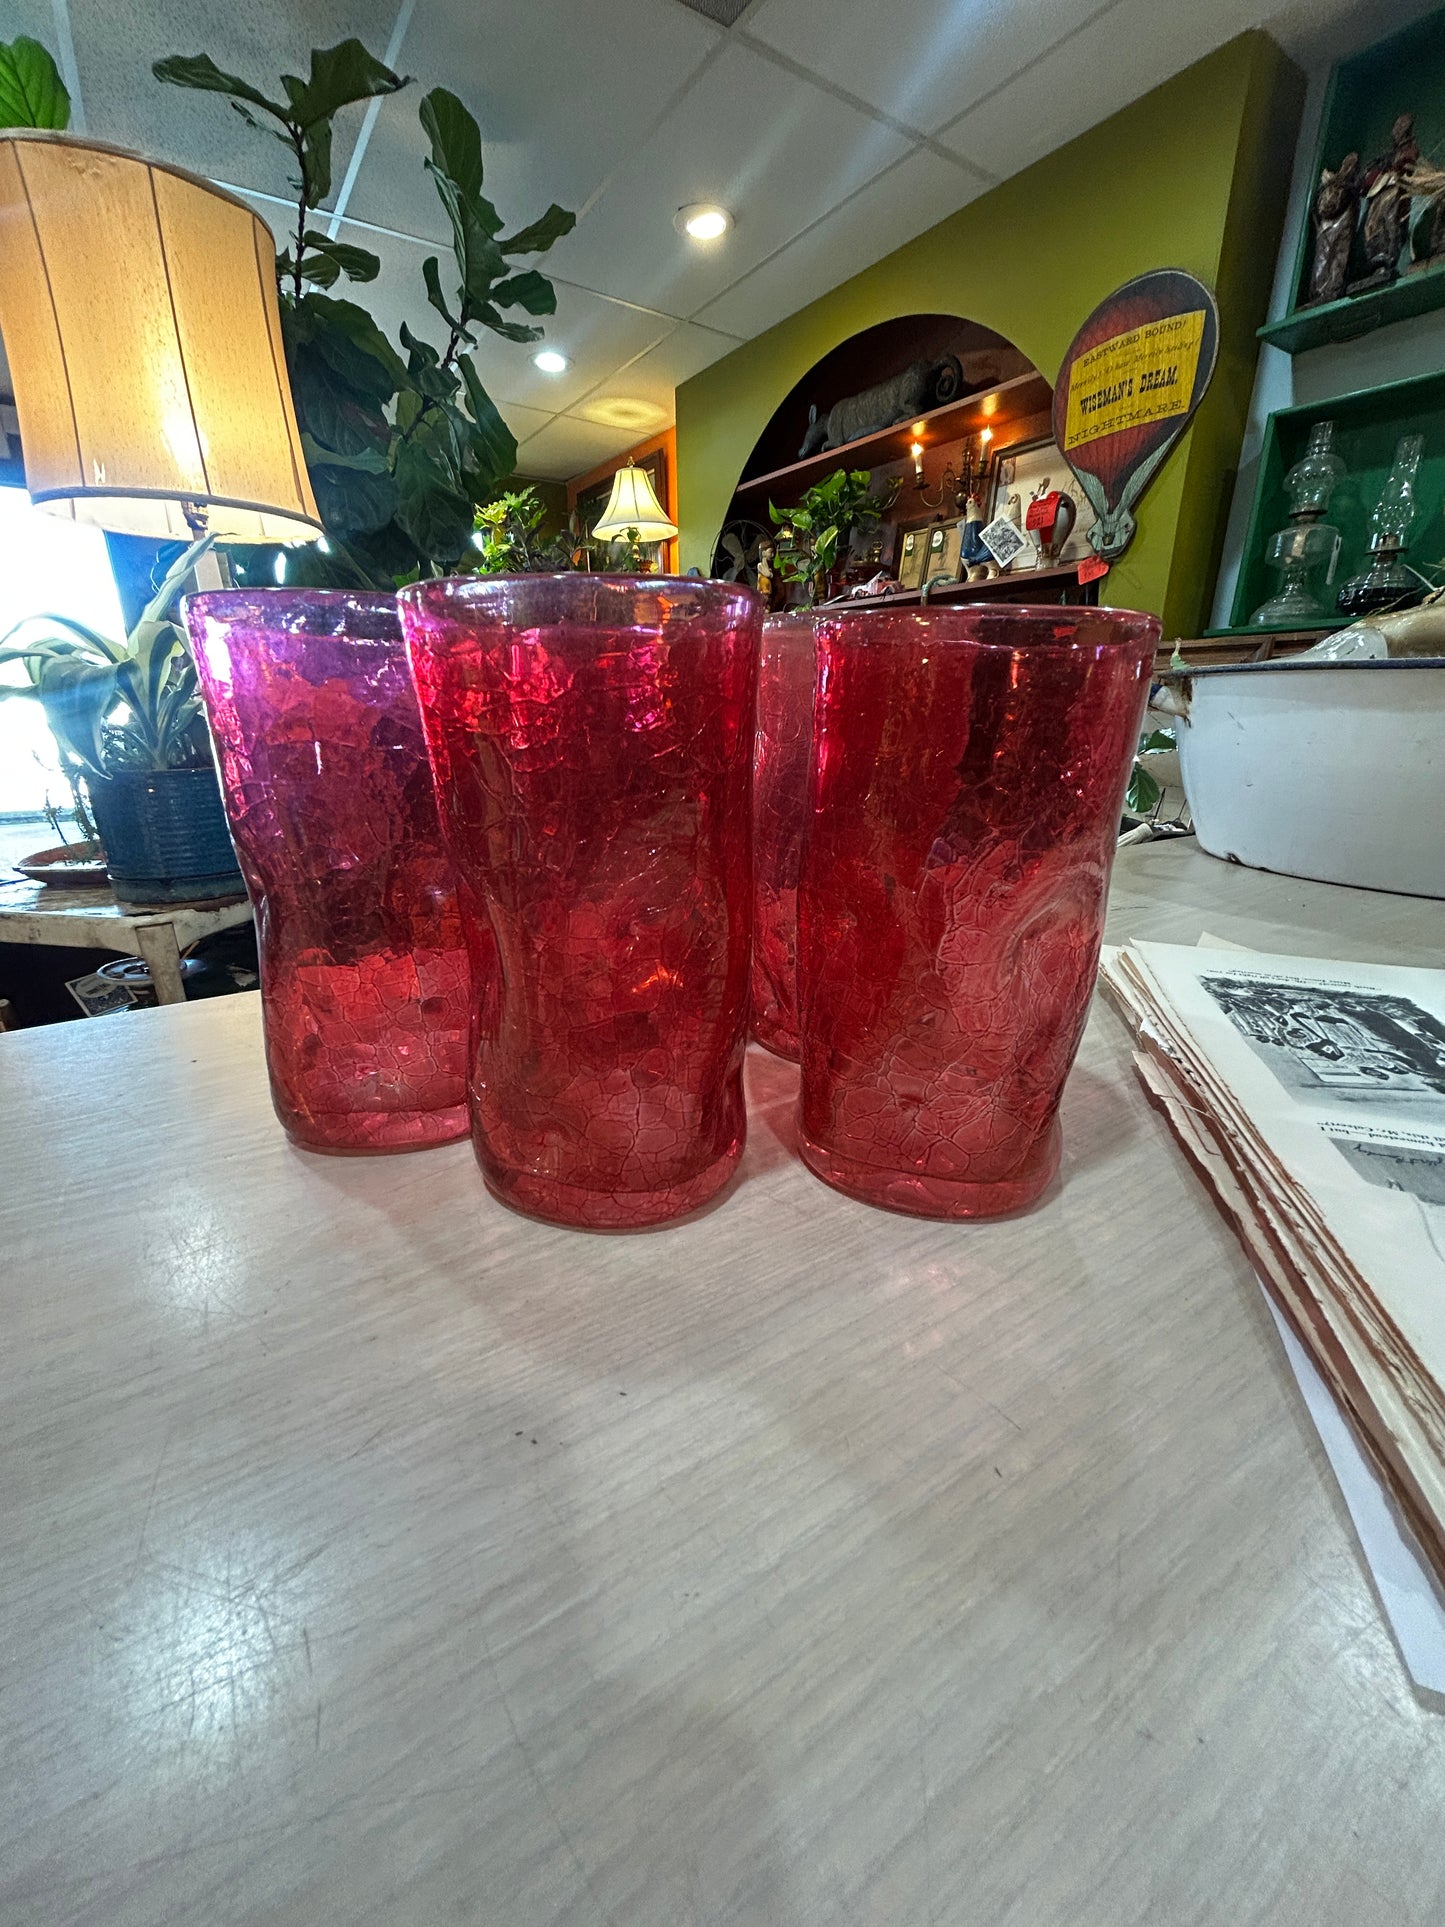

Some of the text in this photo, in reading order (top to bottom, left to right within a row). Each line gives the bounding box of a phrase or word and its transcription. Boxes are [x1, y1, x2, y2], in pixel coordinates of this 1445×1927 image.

[1083, 320, 1187, 368] EASTWARD BOUND!
[1080, 365, 1178, 416] WISEMAN'S DREAM.
[1068, 399, 1185, 445] NIGHTMARE.
